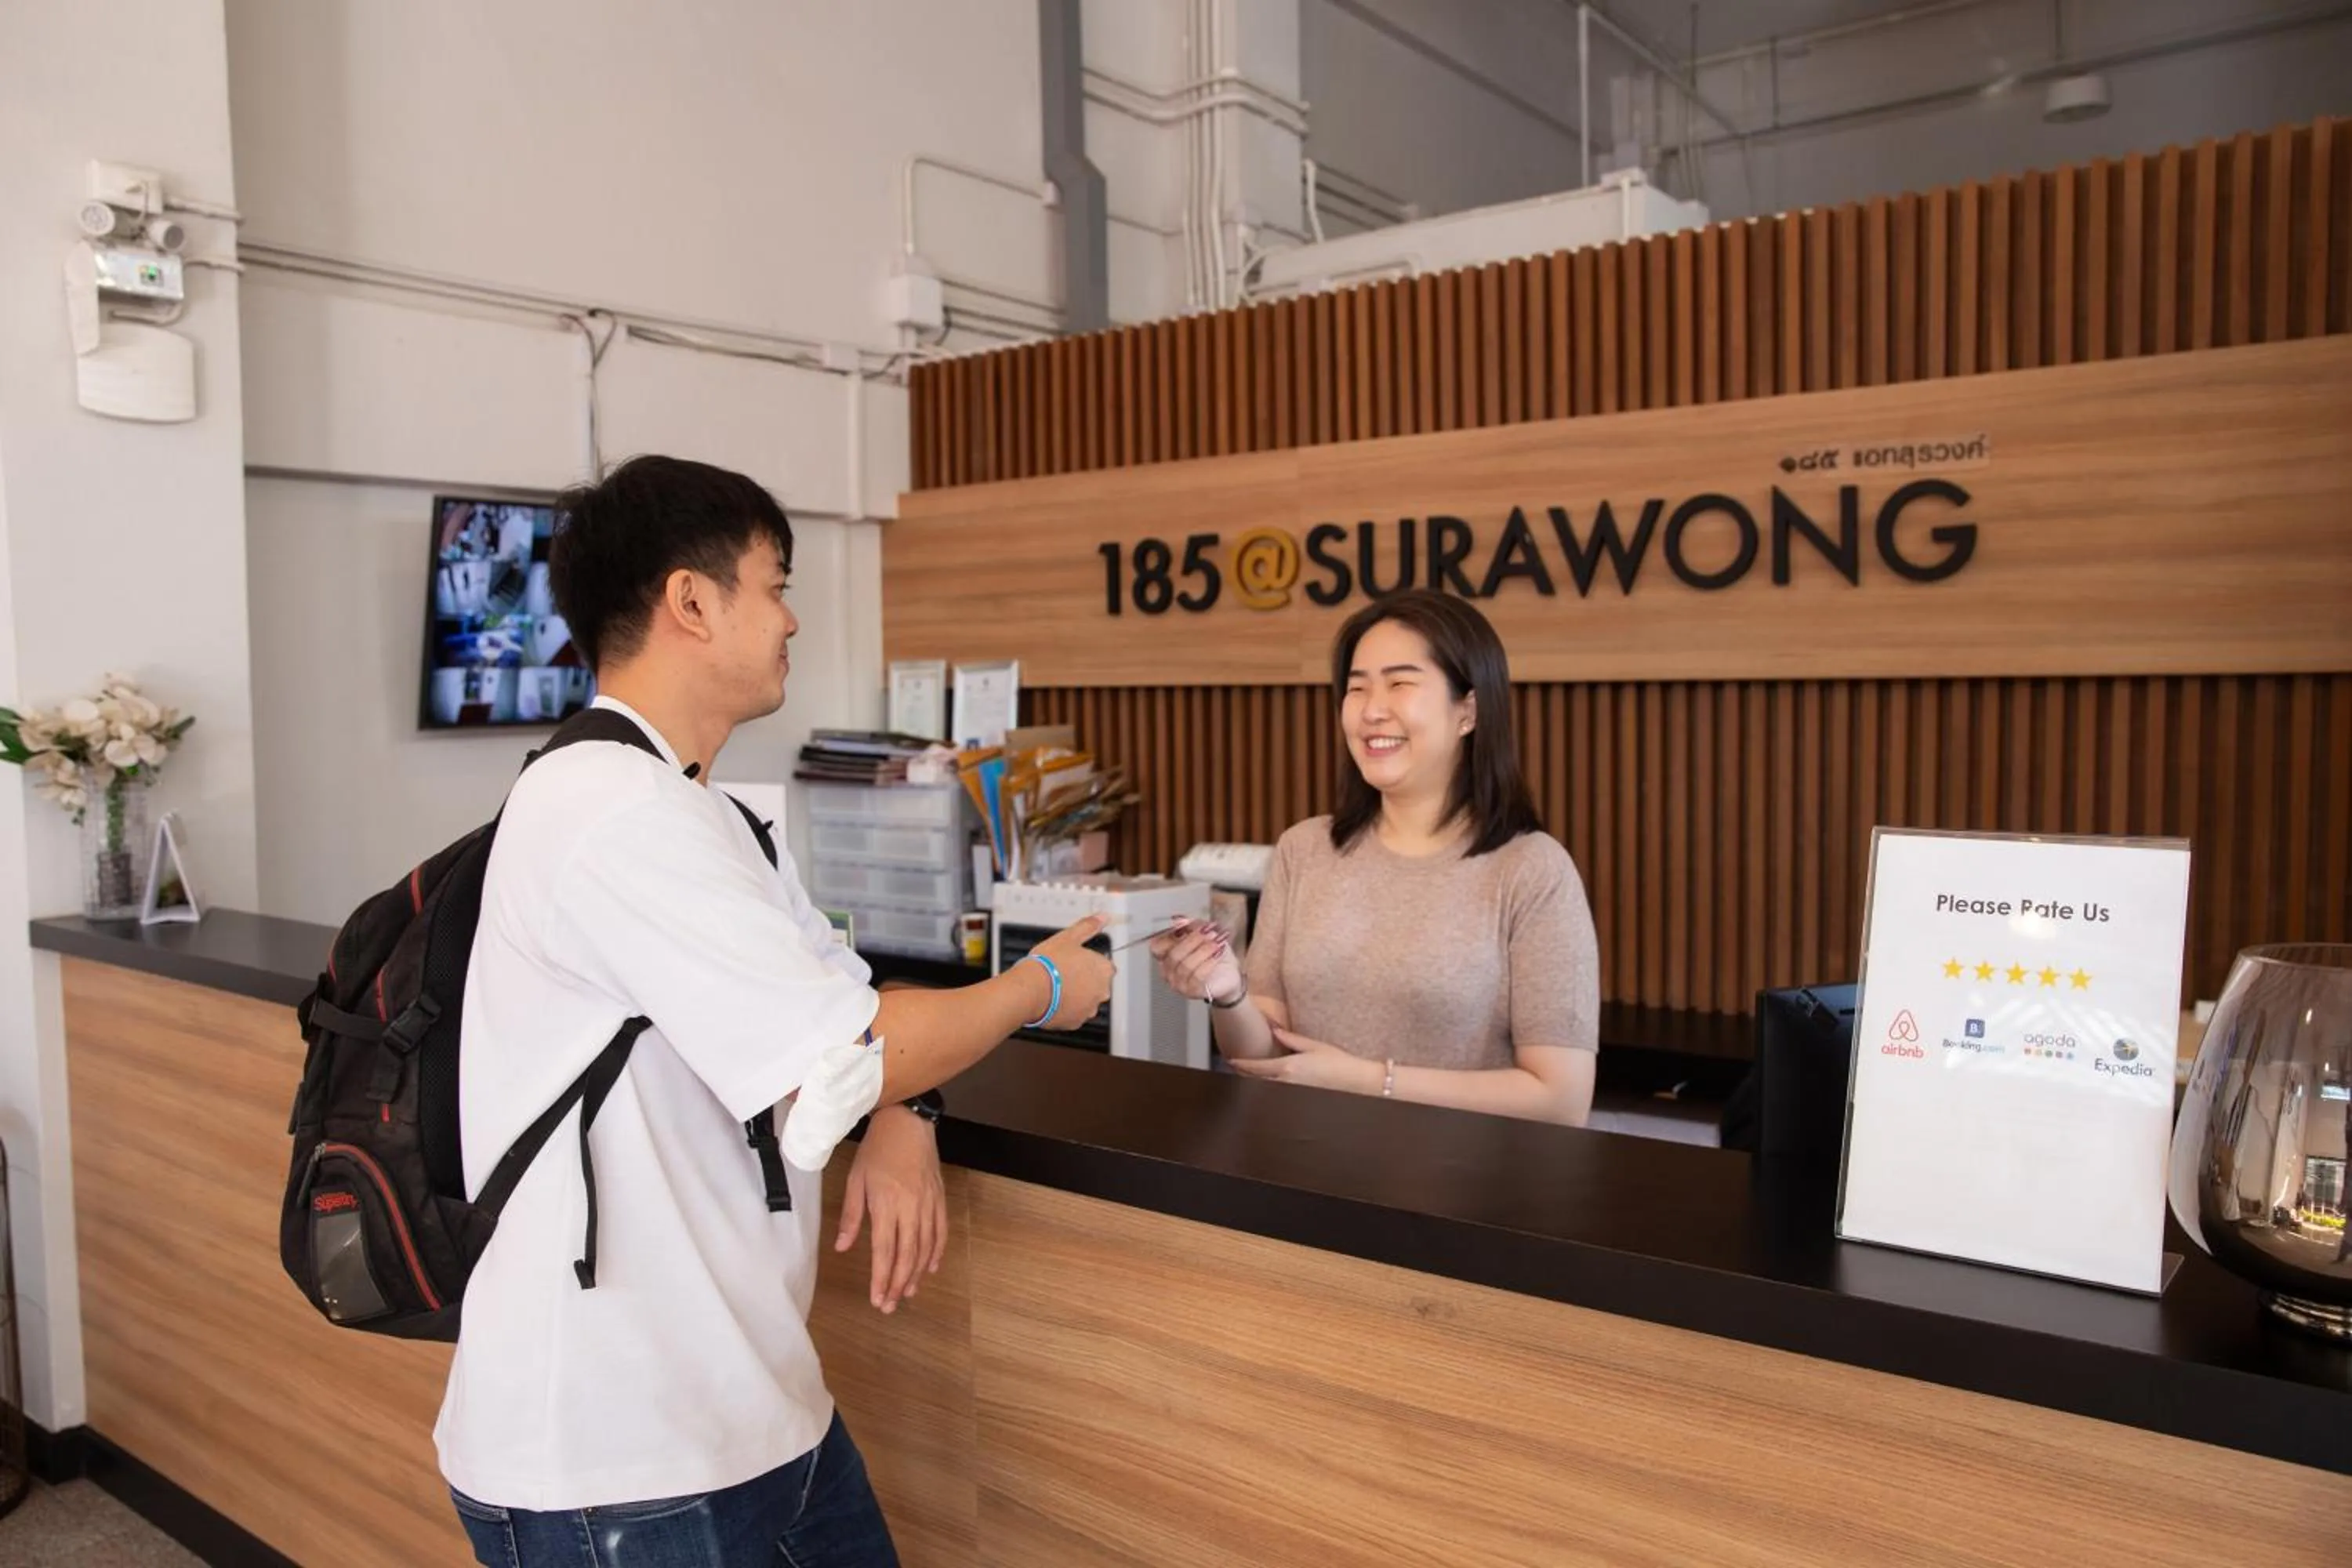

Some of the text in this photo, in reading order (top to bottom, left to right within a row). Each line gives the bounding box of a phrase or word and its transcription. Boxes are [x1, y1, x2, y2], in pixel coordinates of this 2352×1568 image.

[1098, 478, 1978, 615] 185@SURAWONG
[1936, 895, 2012, 916] Please
[2083, 902, 2110, 922] Us
[2024, 1033, 2076, 1047] agoda
[1882, 1044, 1924, 1058] airbnb
[2094, 1058, 2153, 1077] Expedia
